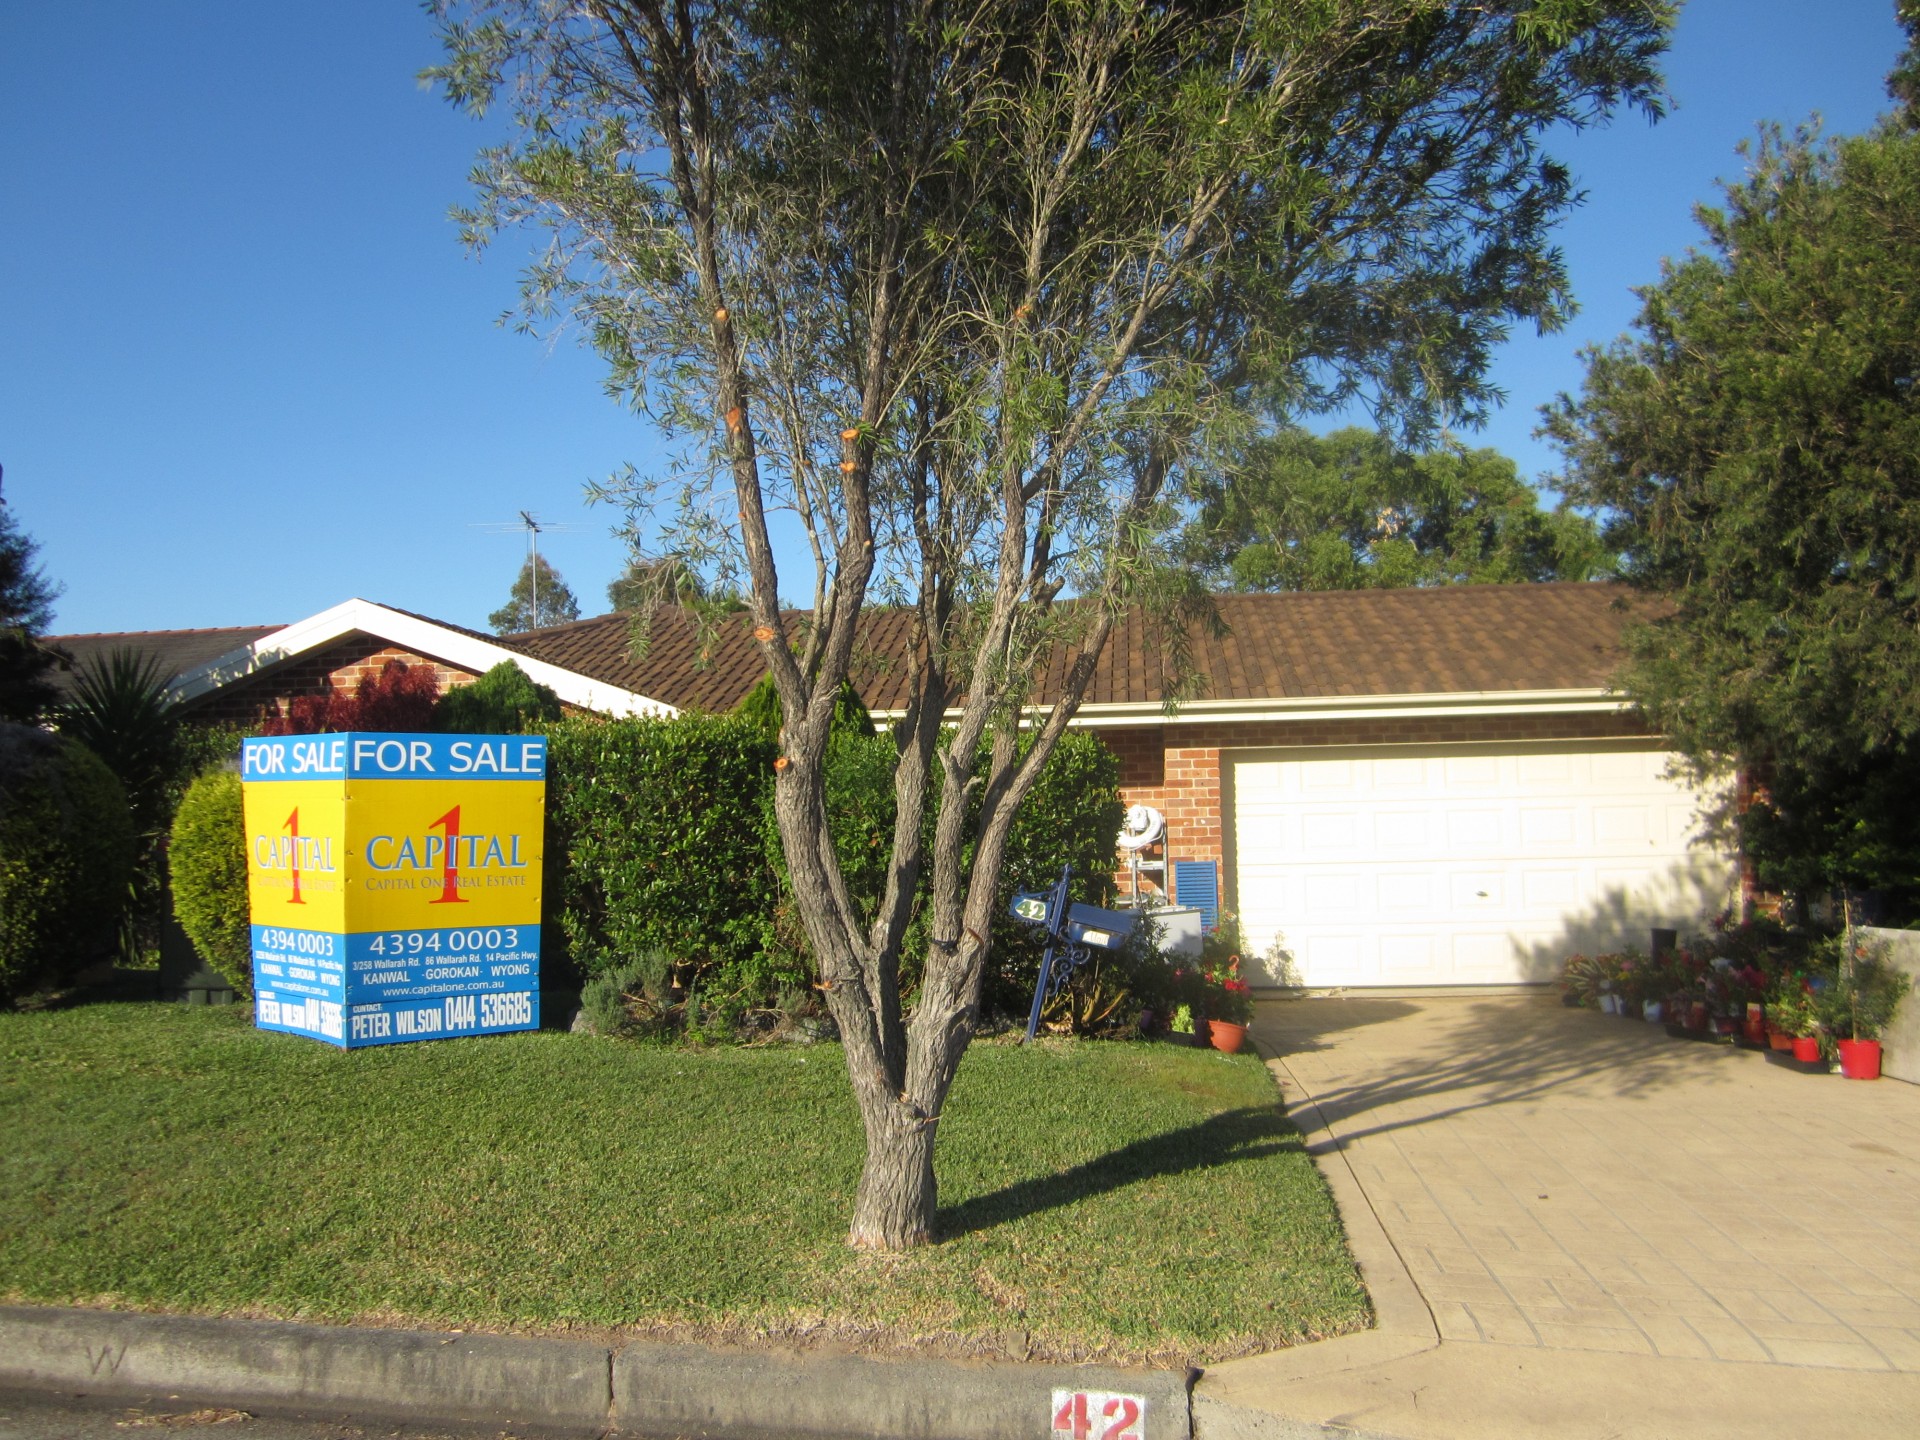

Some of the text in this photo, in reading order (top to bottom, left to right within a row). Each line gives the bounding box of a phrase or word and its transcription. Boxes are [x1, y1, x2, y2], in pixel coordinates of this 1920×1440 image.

[244, 740, 344, 775] FOR SALE
[354, 740, 543, 773] FOR SALE
[255, 835, 336, 872] CAPITAL
[365, 834, 528, 872] CAPITAL
[365, 875, 526, 891] CAPITAL ONE REAL ESTATE
[1016, 900, 1045, 920] 42
[261, 929, 296, 951] 4394
[297, 932, 334, 956] 0003
[369, 928, 518, 955] 4394 0003
[374, 959, 406, 969] Wallarah
[408, 957, 421, 967] Rd.
[425, 956, 434, 965] 86
[436, 955, 467, 965] Wallarah
[468, 954, 481, 963] Rd.
[486, 953, 494, 962] 14
[496, 952, 520, 961] Pacific
[521, 951, 538, 961] Hwy.
[363, 971, 411, 985] KANWAL
[490, 964, 530, 976] WYONG
[383, 981, 504, 997] www.capitalone.com.au
[353, 991, 532, 1039] PETER WILSON 0414 536685
[1053, 1393, 1140, 1440] 42
